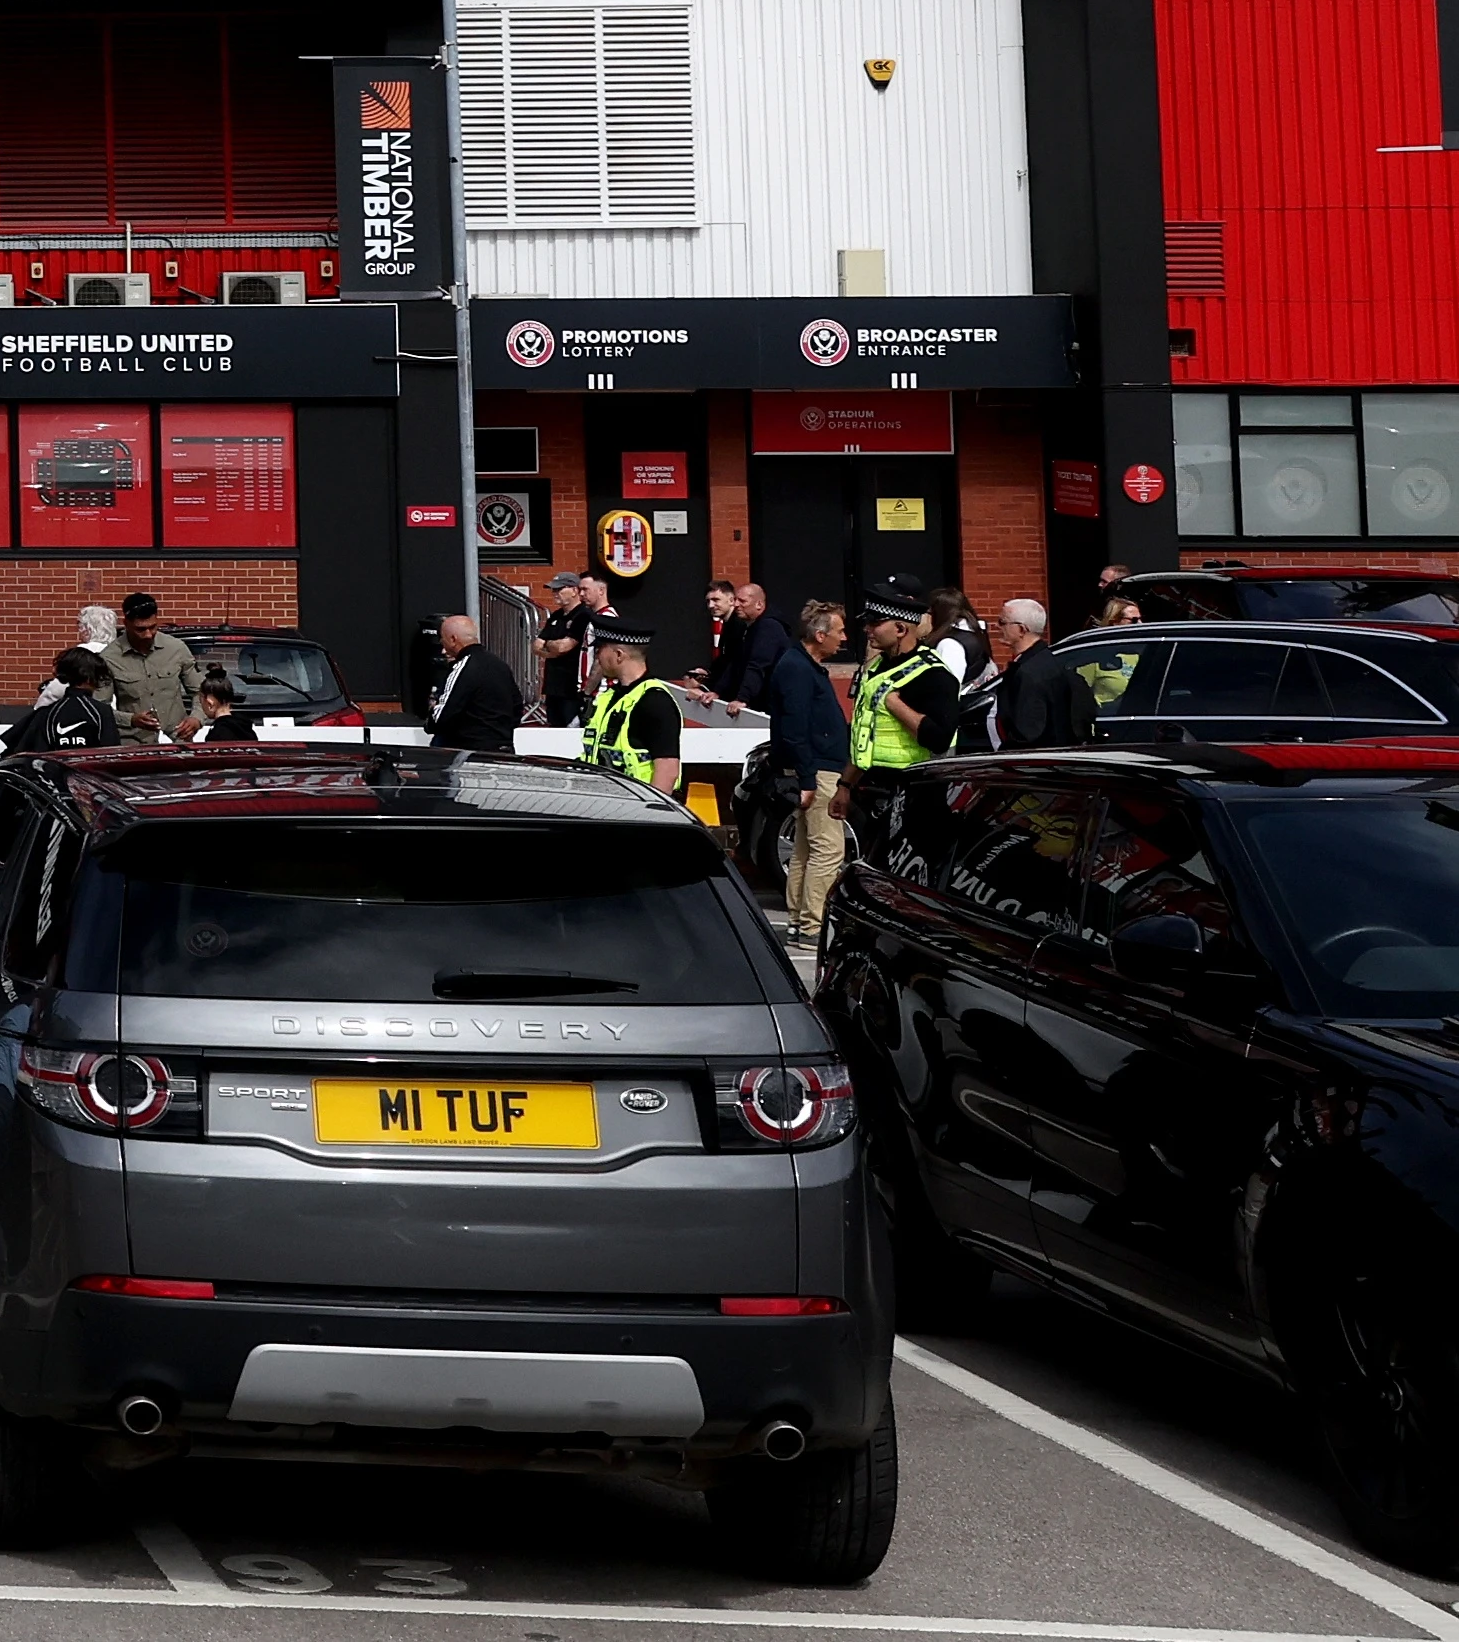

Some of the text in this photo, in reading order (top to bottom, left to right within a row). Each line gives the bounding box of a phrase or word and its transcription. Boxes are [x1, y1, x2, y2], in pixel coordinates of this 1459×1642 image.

[361, 132, 392, 260] TIMBER
[389, 132, 415, 261] NATIONAL
[365, 262, 416, 275] GROUP
[562, 329, 689, 344] PROMOTIONS
[856, 328, 998, 343] BROADCASTER
[1, 334, 234, 354] SHEFFIELD UNITED
[562, 346, 635, 357] LOTTERY
[857, 344, 947, 356] ENTRANCE
[2, 357, 233, 373] FOOTBALL CLUB
[827, 410, 875, 419] STADIUM
[828, 420, 902, 430] OPERATIONS
[59, 736, 86, 746] AIR
[271, 1015, 630, 1041] DISCOVERY
[218, 1086, 307, 1100] SPORT
[436, 1090, 528, 1134] TUF
[221, 1553, 468, 1596] 93
